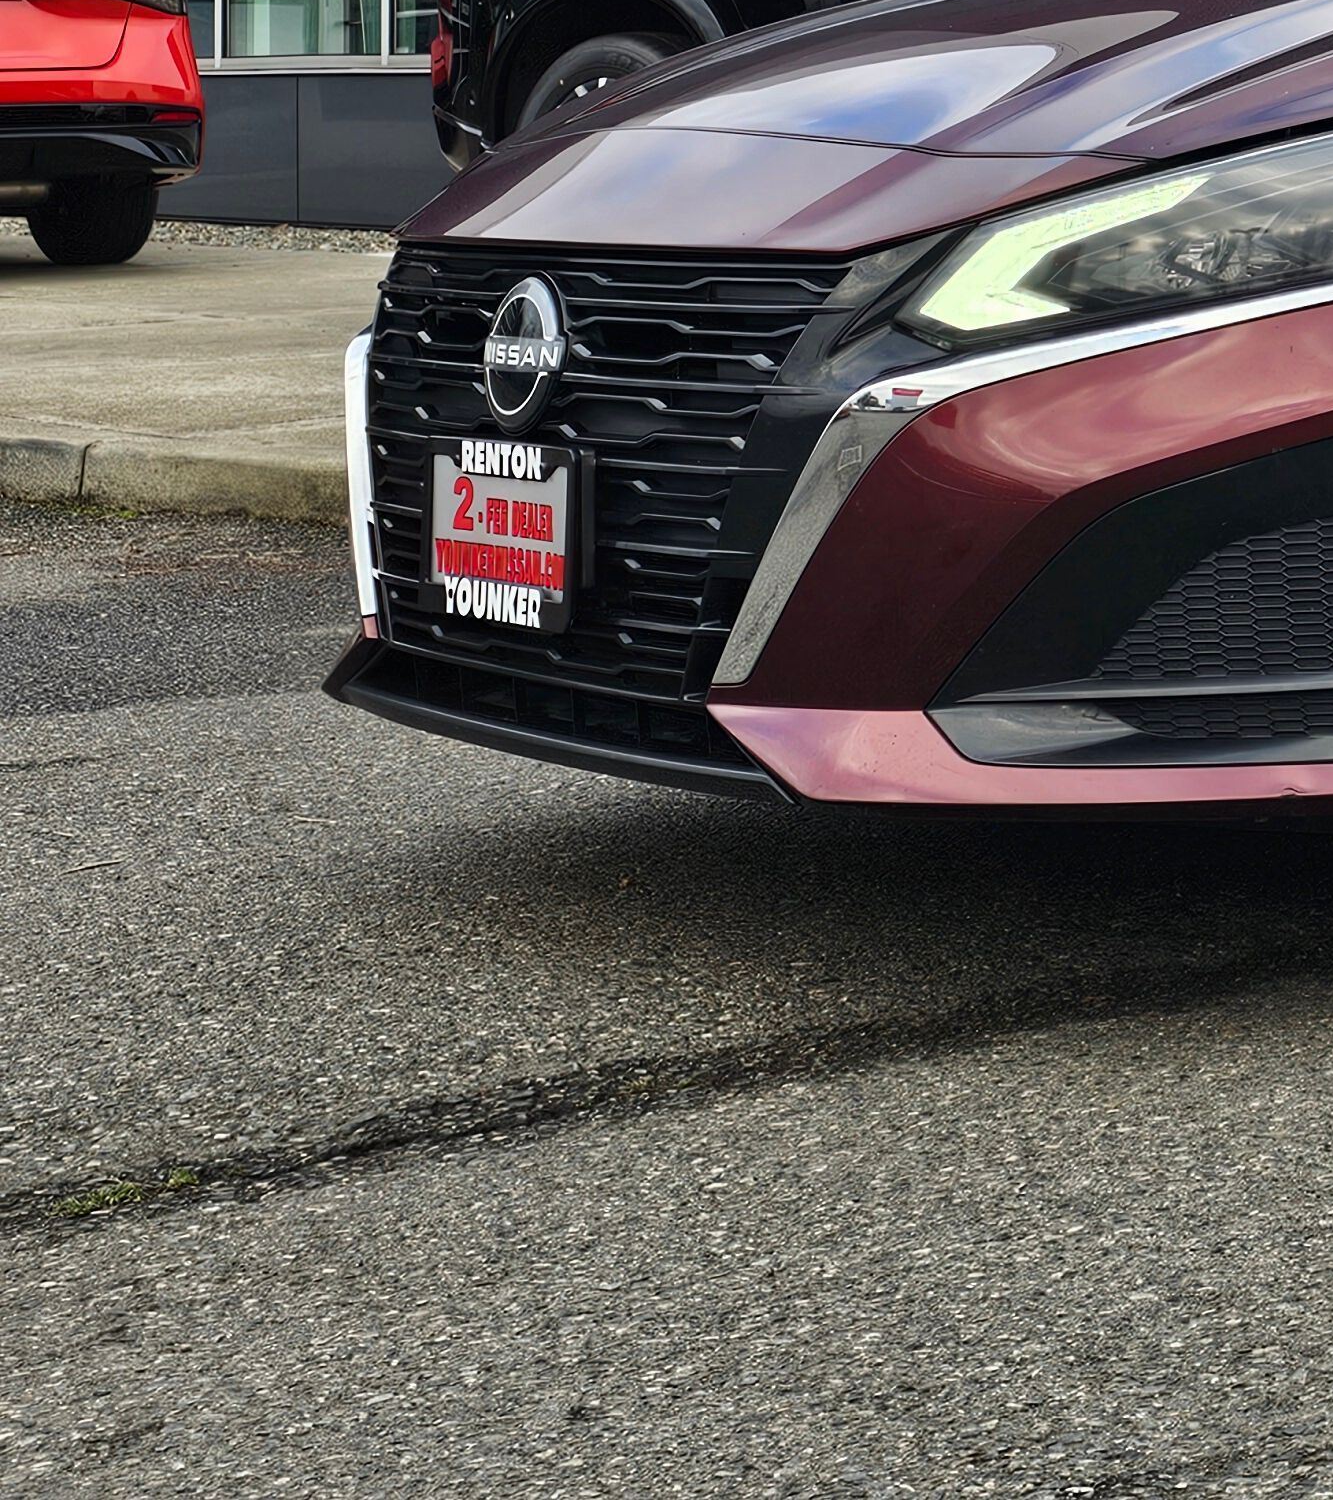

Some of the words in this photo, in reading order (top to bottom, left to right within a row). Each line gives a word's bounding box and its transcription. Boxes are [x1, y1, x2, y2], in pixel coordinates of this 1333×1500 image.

[484, 341, 559, 368] NISSAN
[461, 440, 542, 481] RENTON
[511, 500, 554, 543] DEALER
[443, 576, 541, 629] YOUNKER
